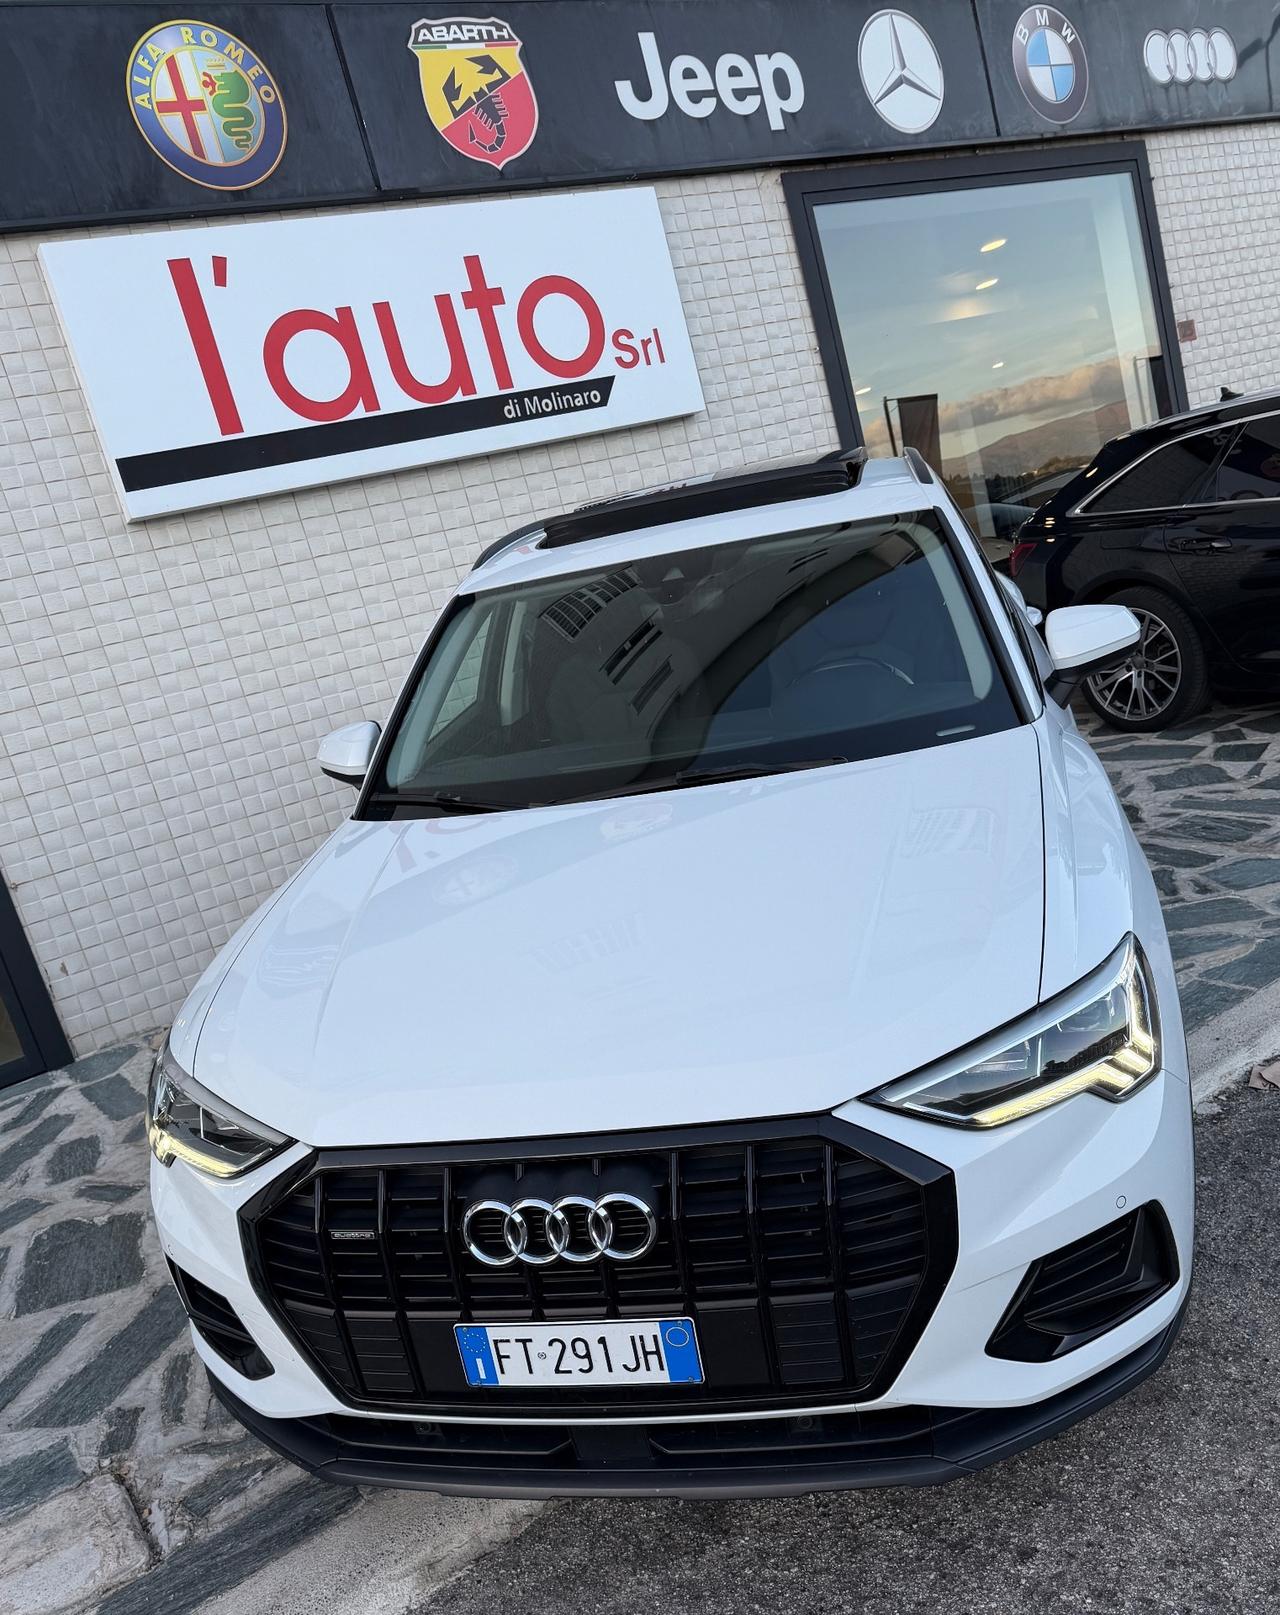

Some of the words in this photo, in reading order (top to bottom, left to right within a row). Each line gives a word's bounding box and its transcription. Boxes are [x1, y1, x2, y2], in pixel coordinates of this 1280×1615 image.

[418, 24, 509, 42] ABARTH
[1016, 9, 1076, 46] BMW
[135, 42, 166, 109] ALFA
[180, 26, 276, 104] ROMEO
[614, 32, 805, 131] Jeep
[167, 254, 606, 436] l'auto
[611, 328, 666, 369] Srl
[503, 399, 521, 419] di
[524, 389, 601, 416] Molinaro
